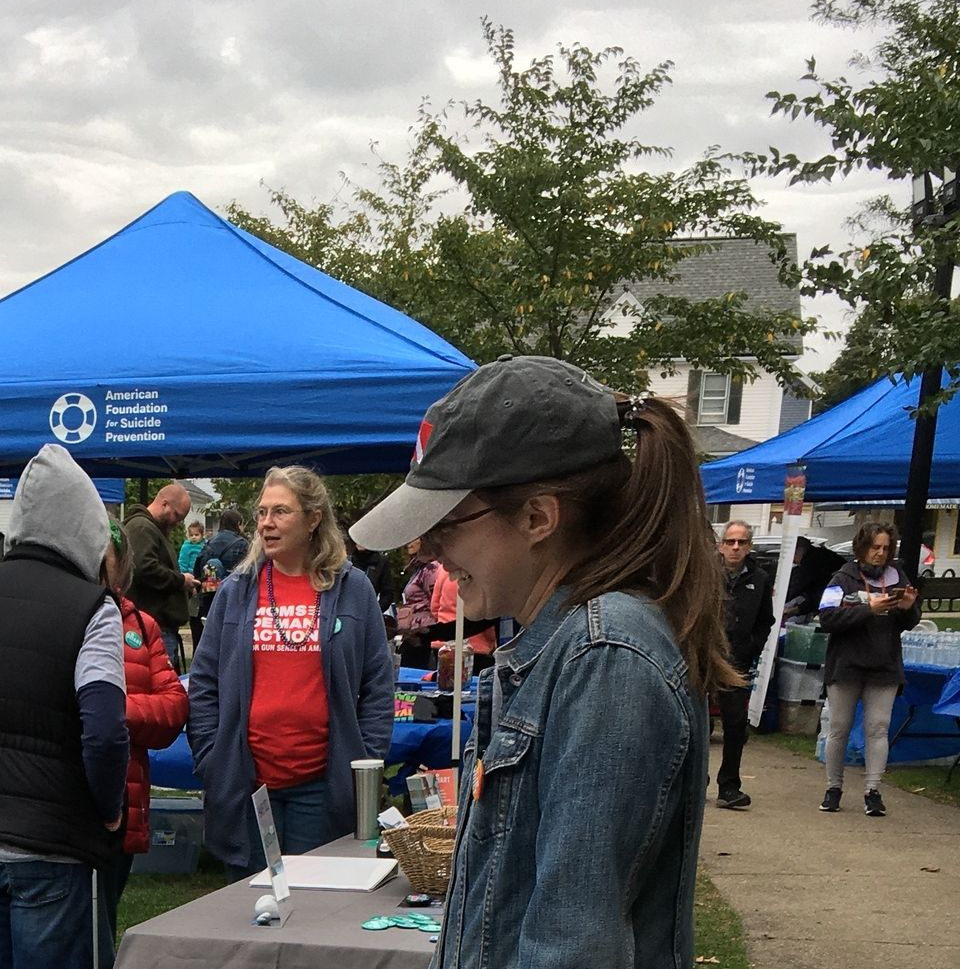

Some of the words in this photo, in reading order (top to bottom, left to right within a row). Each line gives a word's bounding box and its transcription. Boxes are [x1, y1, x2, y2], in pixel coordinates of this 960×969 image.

[105, 389, 159, 401] American
[105, 403, 168, 415] Foundation
[105, 418, 119, 429] for
[120, 416, 161, 428] Suicide
[105, 430, 165, 442] Prevention
[254, 617, 320, 629] DEMAN
